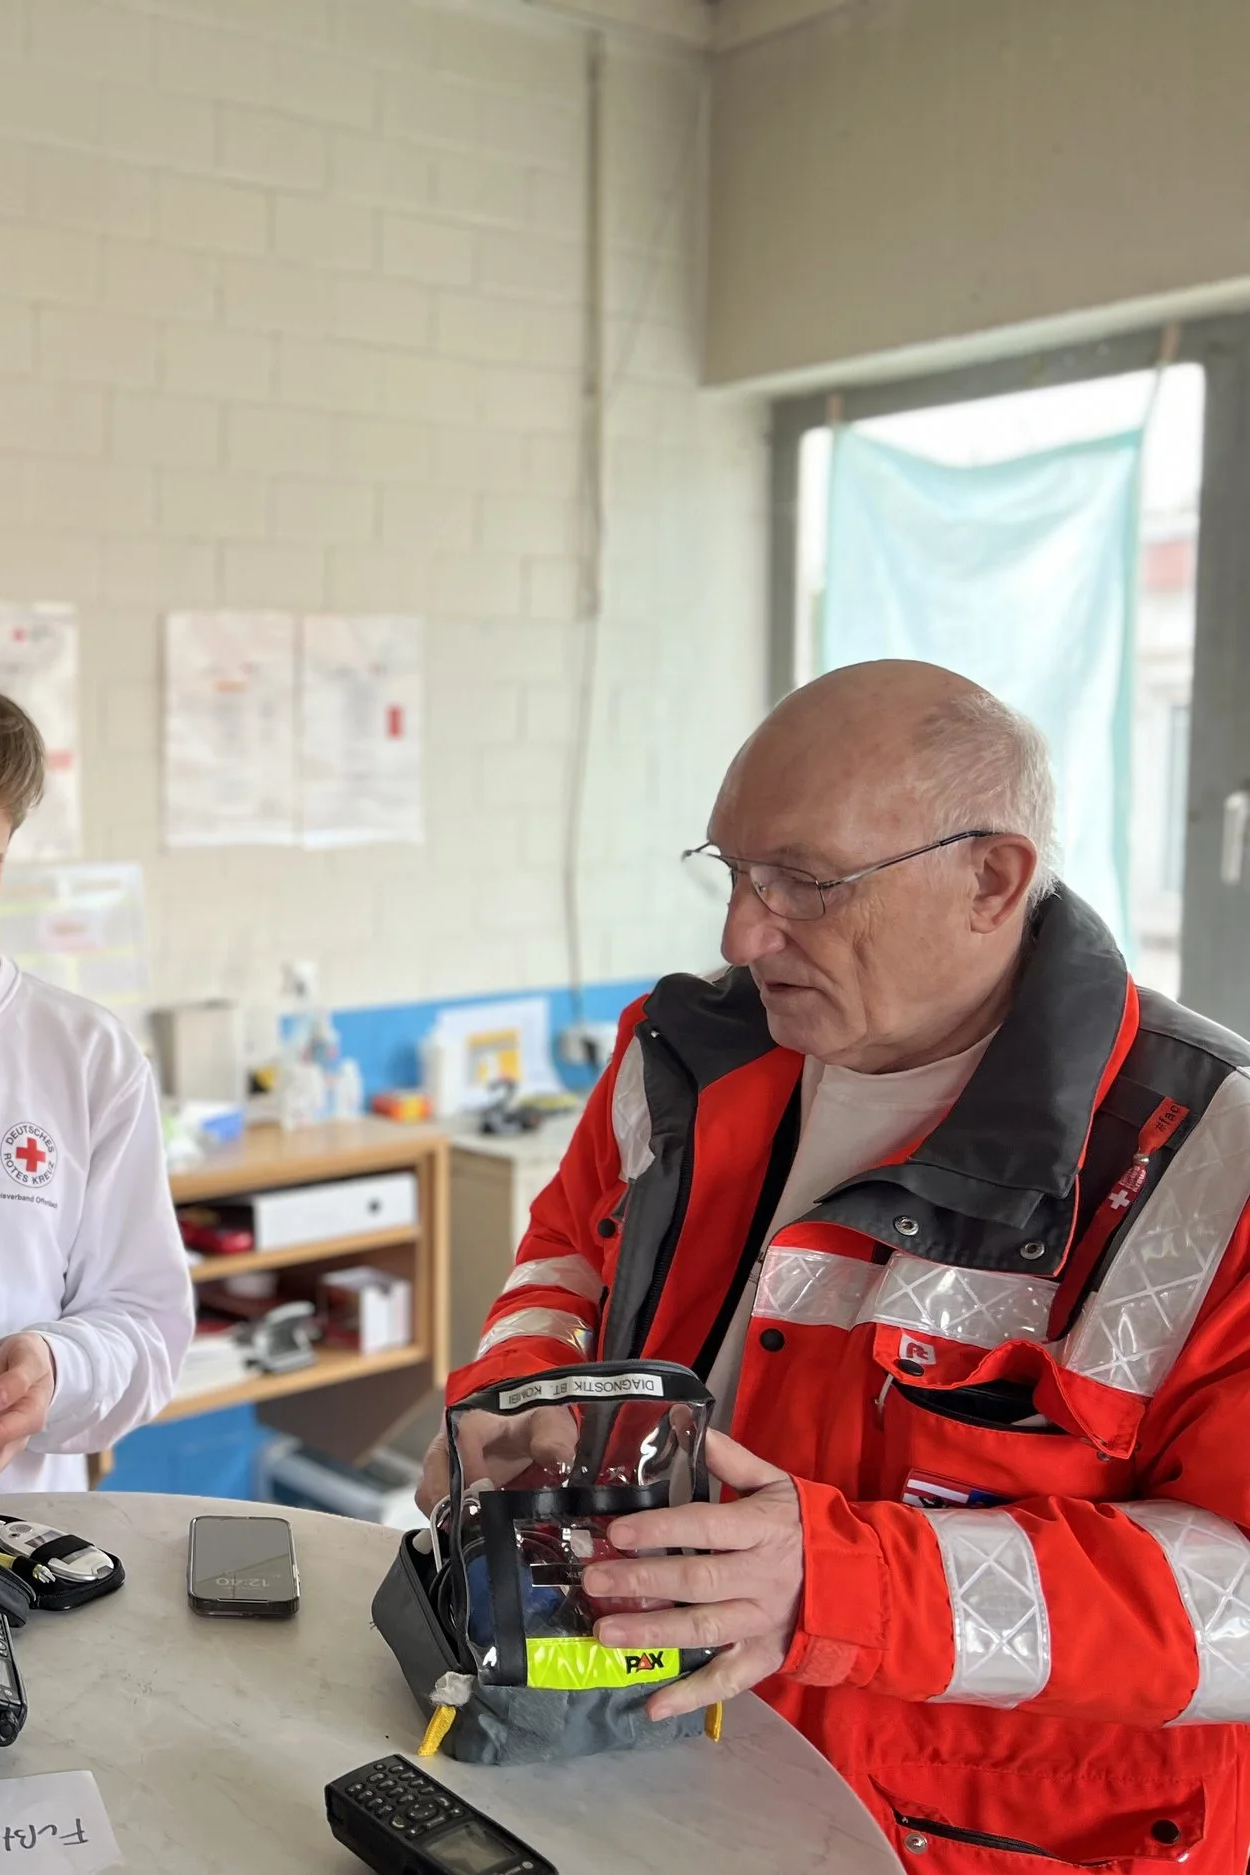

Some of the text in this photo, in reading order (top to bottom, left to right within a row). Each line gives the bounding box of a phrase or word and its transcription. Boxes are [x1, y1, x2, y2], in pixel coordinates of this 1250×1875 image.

[5, 1125, 55, 1153] DEUTSCHES
[4, 1152, 55, 1185] ROTES KREUZ
[508, 1385, 543, 1405] KOMBI
[574, 1378, 655, 1394] DIAGNOSTIK
[625, 1651, 664, 1674] PAX
